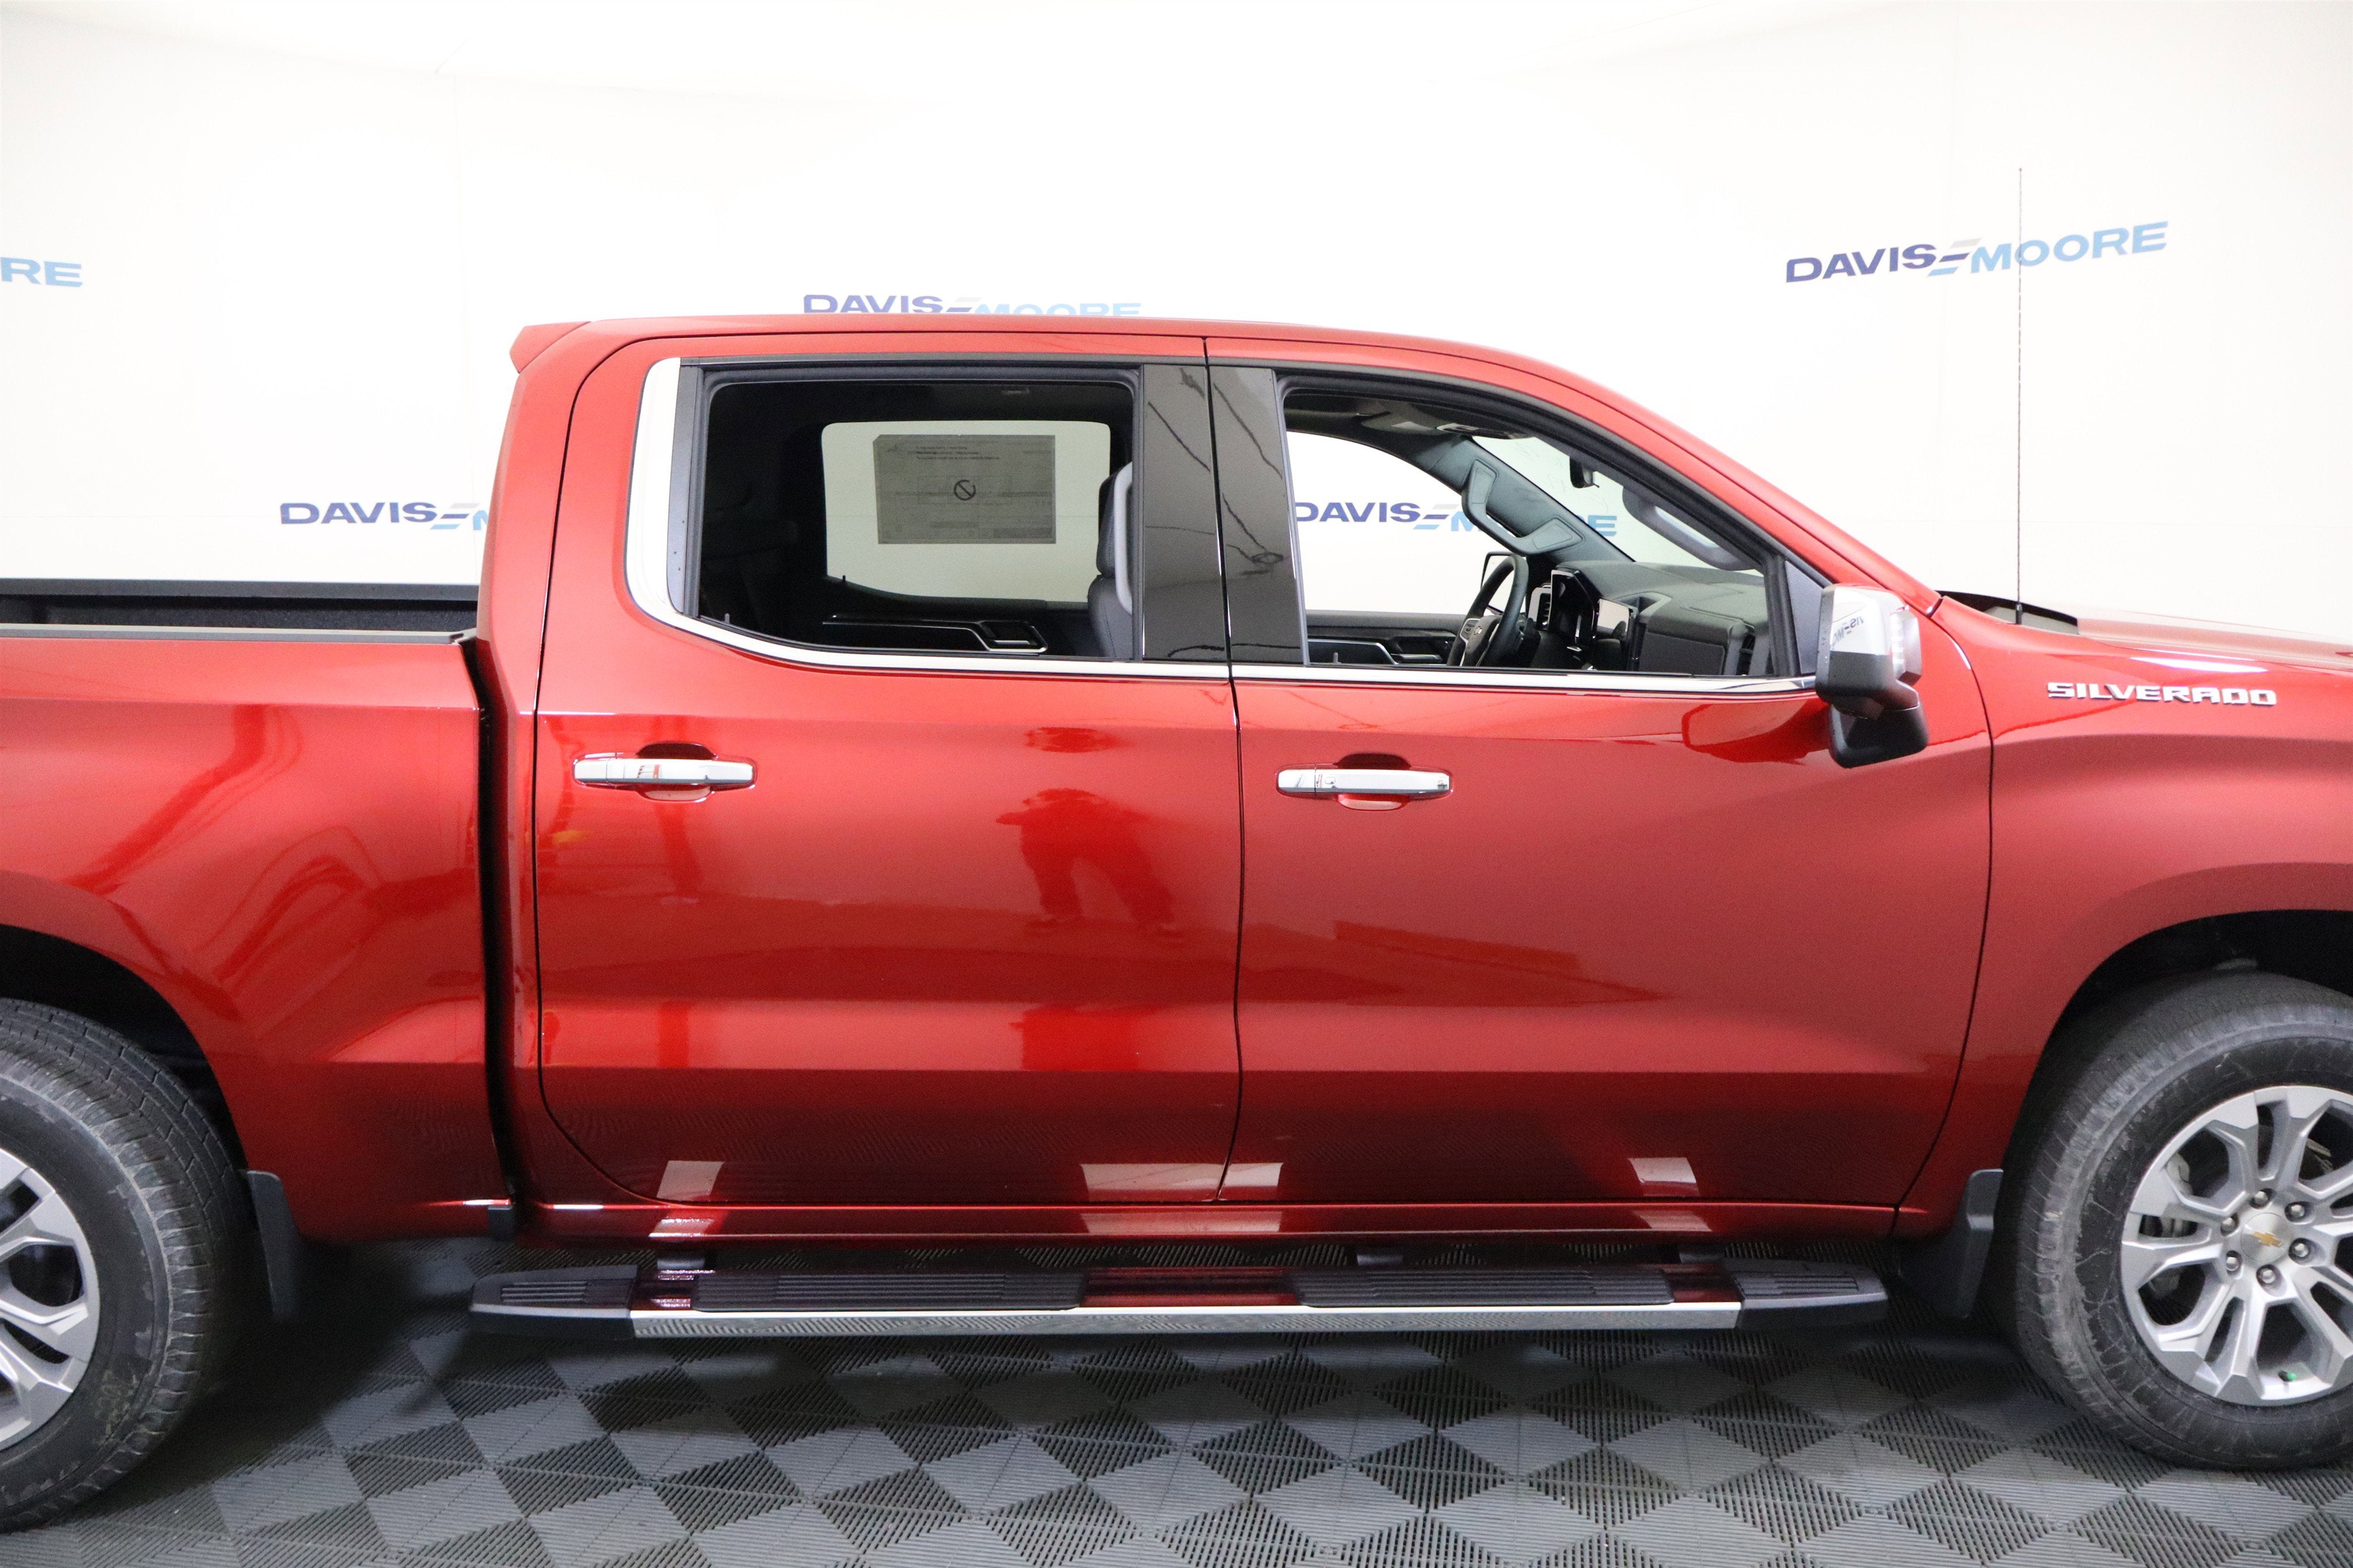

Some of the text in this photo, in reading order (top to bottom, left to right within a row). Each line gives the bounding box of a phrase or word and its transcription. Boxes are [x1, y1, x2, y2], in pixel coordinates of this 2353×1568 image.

[1786, 221, 2169, 283] DAVIS MOORE
[804, 294, 943, 313] DAVIS
[280, 501, 438, 524] DAVIS
[2047, 682, 2277, 706] SILVERADO
